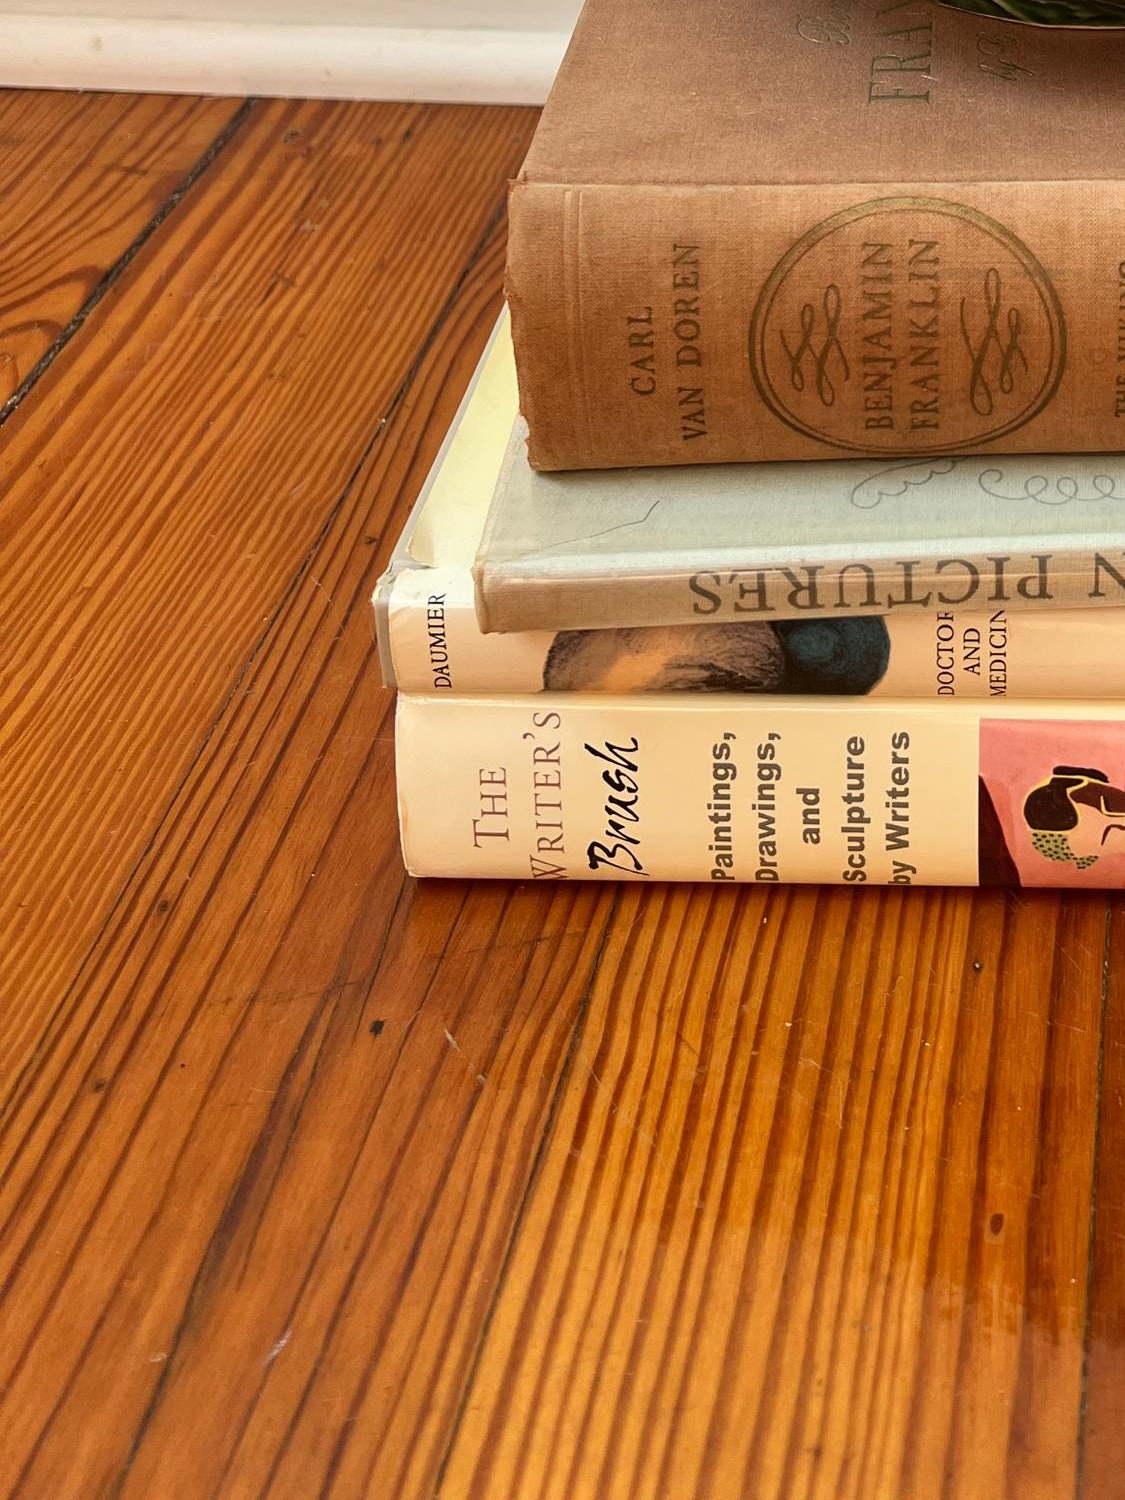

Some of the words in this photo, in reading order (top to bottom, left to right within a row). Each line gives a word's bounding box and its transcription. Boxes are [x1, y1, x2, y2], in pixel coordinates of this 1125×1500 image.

[627, 306, 657, 396] CARL
[672, 243, 703, 368] DOREN
[862, 241, 897, 431] BENJAMIN
[908, 239, 940, 433] FRANKLIN
[676, 386, 709, 441] VAN
[687, 553, 1054, 615] PICTURES
[427, 592, 453, 689] DAUMIER
[936, 609, 955, 696] DOCTO
[963, 627, 981, 676] AND
[988, 609, 1007, 697] MEDICIN
[471, 765, 511, 849] THE
[583, 736, 651, 877] Brush
[706, 731, 738, 881] Paintings,
[751, 731, 782, 882] Drawings,
[796, 787, 821, 845] and
[840, 735, 872, 883] Sculpture
[885, 730, 911, 851] Writers
[887, 859, 917, 885] by
